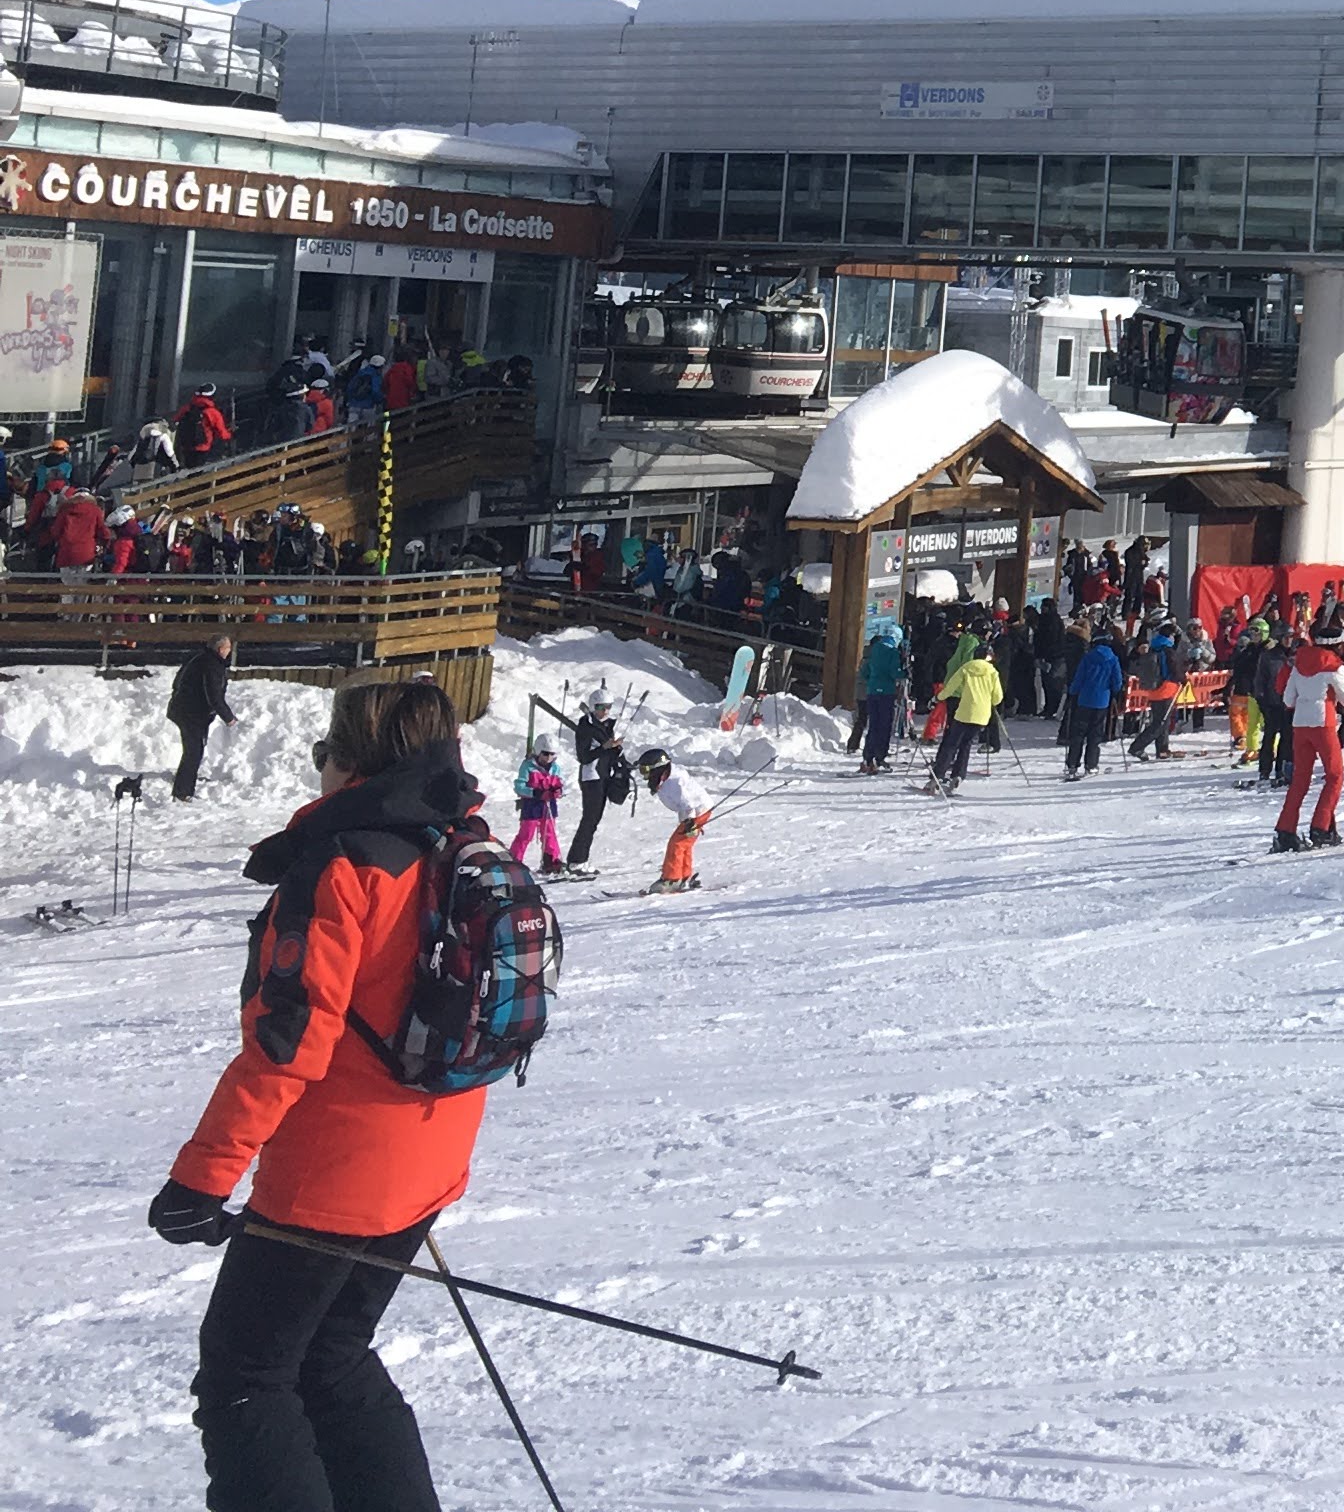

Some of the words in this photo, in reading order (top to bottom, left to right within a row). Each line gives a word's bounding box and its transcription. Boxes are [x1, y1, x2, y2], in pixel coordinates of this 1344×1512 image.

[920, 87, 985, 104] VERDONS
[38, 162, 334, 224] COURCHEVEL
[350, 197, 409, 230] 1850
[430, 205, 457, 233] La
[463, 208, 554, 240] Croisette
[309, 240, 352, 257] CHENUS
[408, 247, 453, 264] VERDONS
[759, 375, 815, 387] COURCHEVEL
[912, 531, 958, 553] CHENUS
[973, 525, 1018, 547] VERDONS
